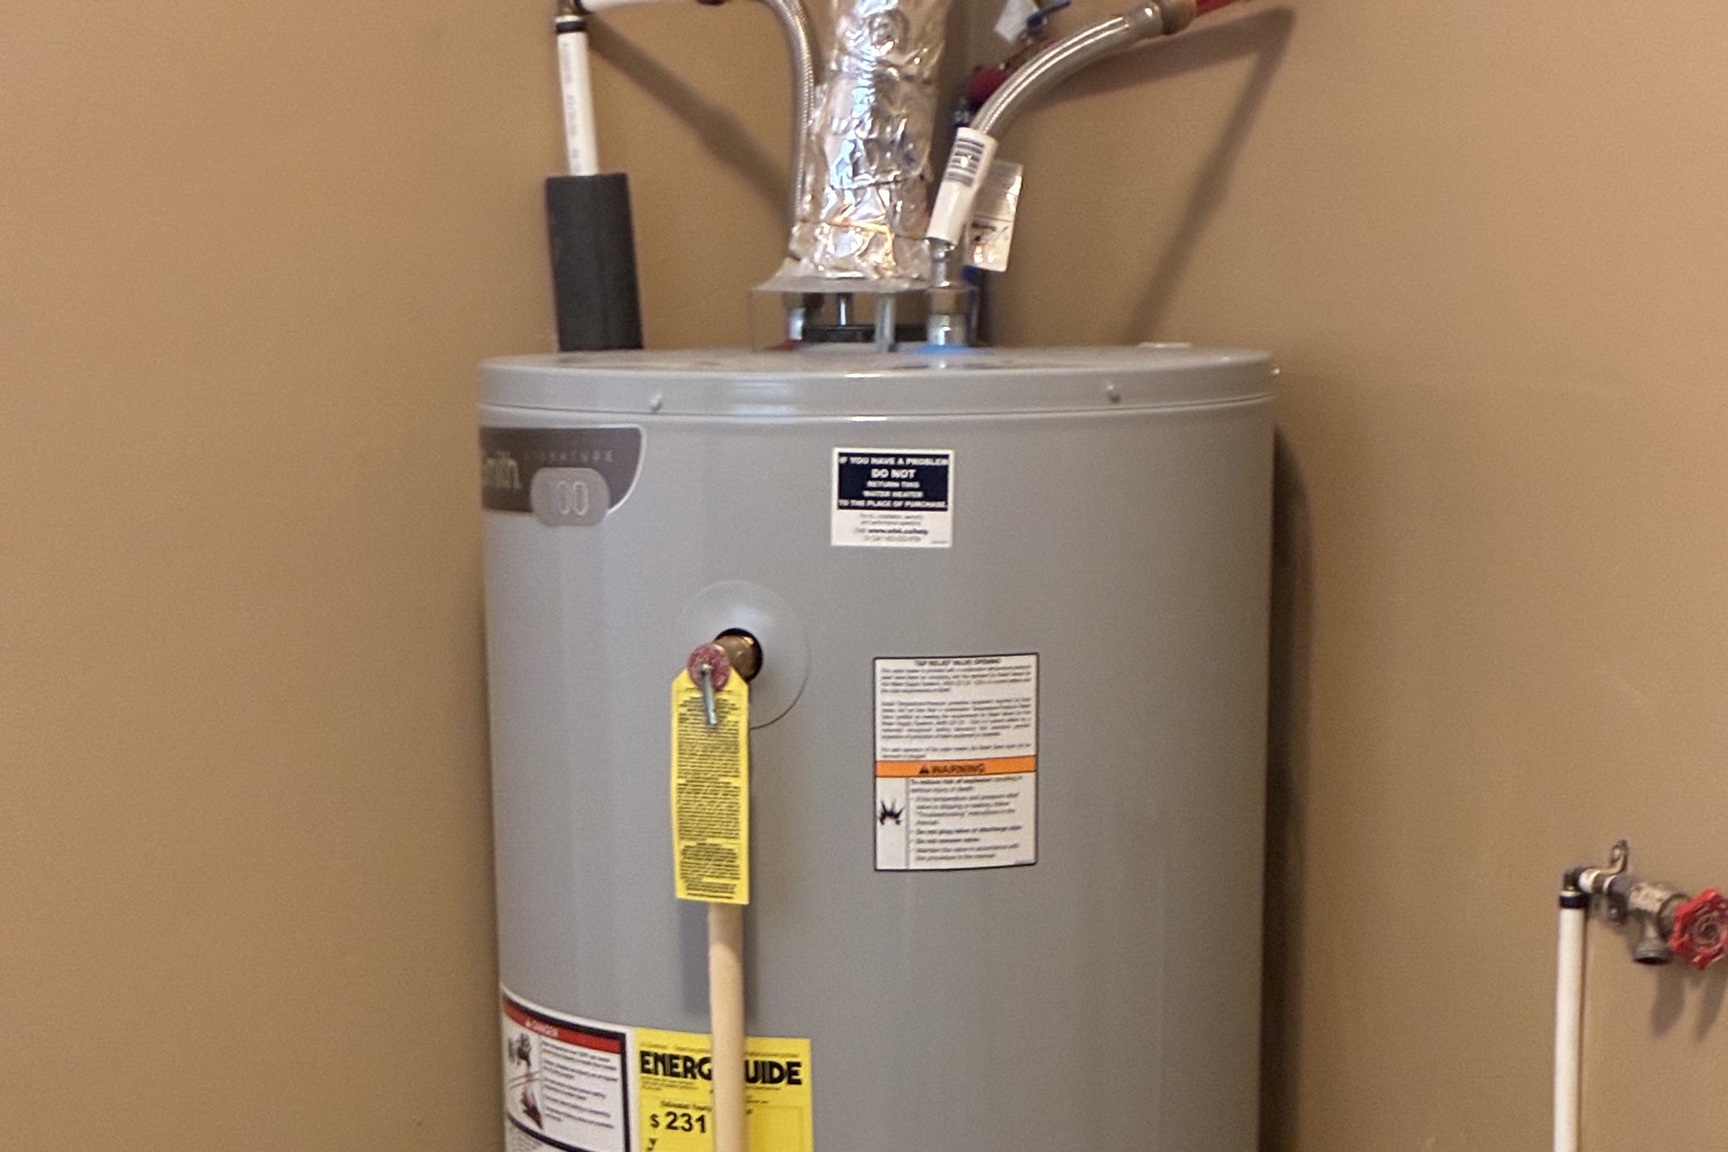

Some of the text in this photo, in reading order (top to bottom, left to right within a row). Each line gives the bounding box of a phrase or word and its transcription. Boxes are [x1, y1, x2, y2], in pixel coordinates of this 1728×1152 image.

[850, 456, 869, 465] YOU
[870, 457, 895, 465] HAVE
[897, 457, 905, 465] A
[906, 457, 949, 466] PROBLEM
[871, 468, 916, 479] DO NOT
[931, 763, 986, 774] WARNING
[665, 1111, 707, 1133] 231
